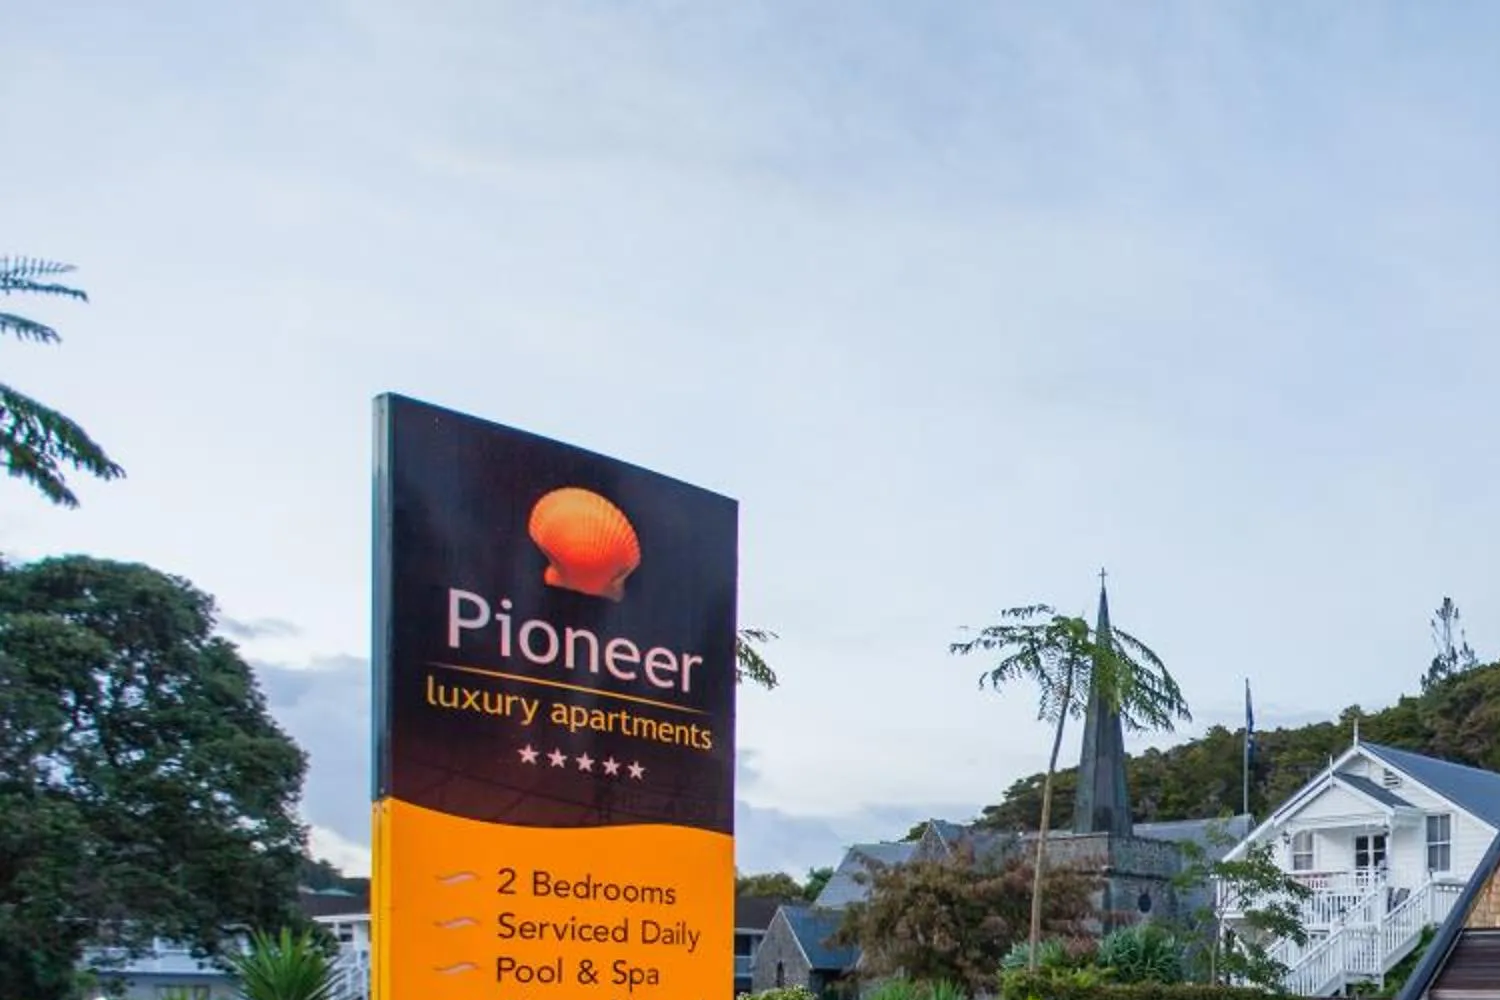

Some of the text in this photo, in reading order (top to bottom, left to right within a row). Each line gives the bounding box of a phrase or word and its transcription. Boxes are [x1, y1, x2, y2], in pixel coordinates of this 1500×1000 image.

[447, 588, 703, 692] Pioneer
[426, 675, 712, 748] luxury apartments
[497, 868, 677, 904] 2 Bedrooms
[497, 912, 700, 952] Serviced Daily
[496, 957, 659, 991] Pool & Spa
